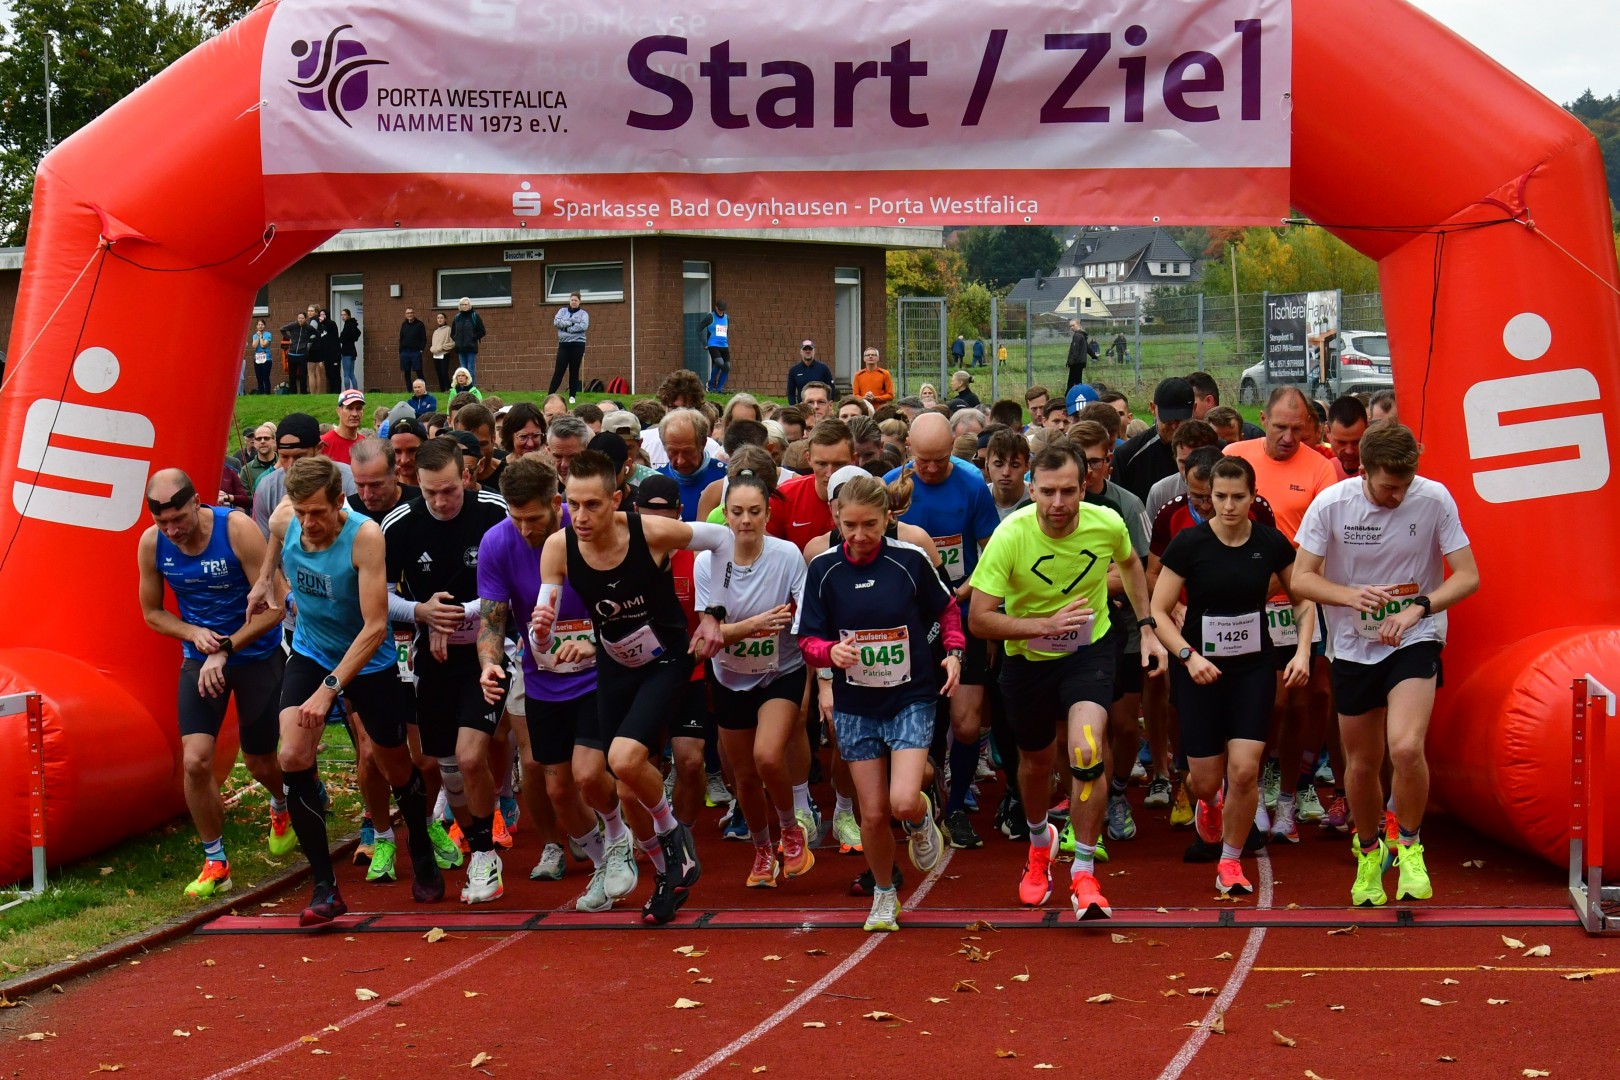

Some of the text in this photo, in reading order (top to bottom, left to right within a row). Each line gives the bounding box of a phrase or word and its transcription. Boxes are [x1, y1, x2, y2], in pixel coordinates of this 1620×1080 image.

[626, 19, 1262, 130] Start / Ziel
[377, 88, 567, 109] PORTA WESTFALICA
[377, 113, 568, 133] NAMMEN 1973 e.V.
[553, 198, 660, 221] Sparkasse
[670, 198, 709, 217] Bad
[716, 197, 847, 221] Oeynhausen
[868, 197, 924, 215] Porta
[929, 195, 1039, 214] Westfalica
[505, 250, 533, 259] Besucher WC
[1268, 302, 1306, 320] Tischlerei
[1343, 531, 1382, 541] Schröer
[297, 571, 328, 592] RUN
[298, 585, 328, 599] CREW
[622, 595, 645, 609] IMI
[856, 632, 888, 641] Laufserie
[1216, 630, 1249, 642] 1426
